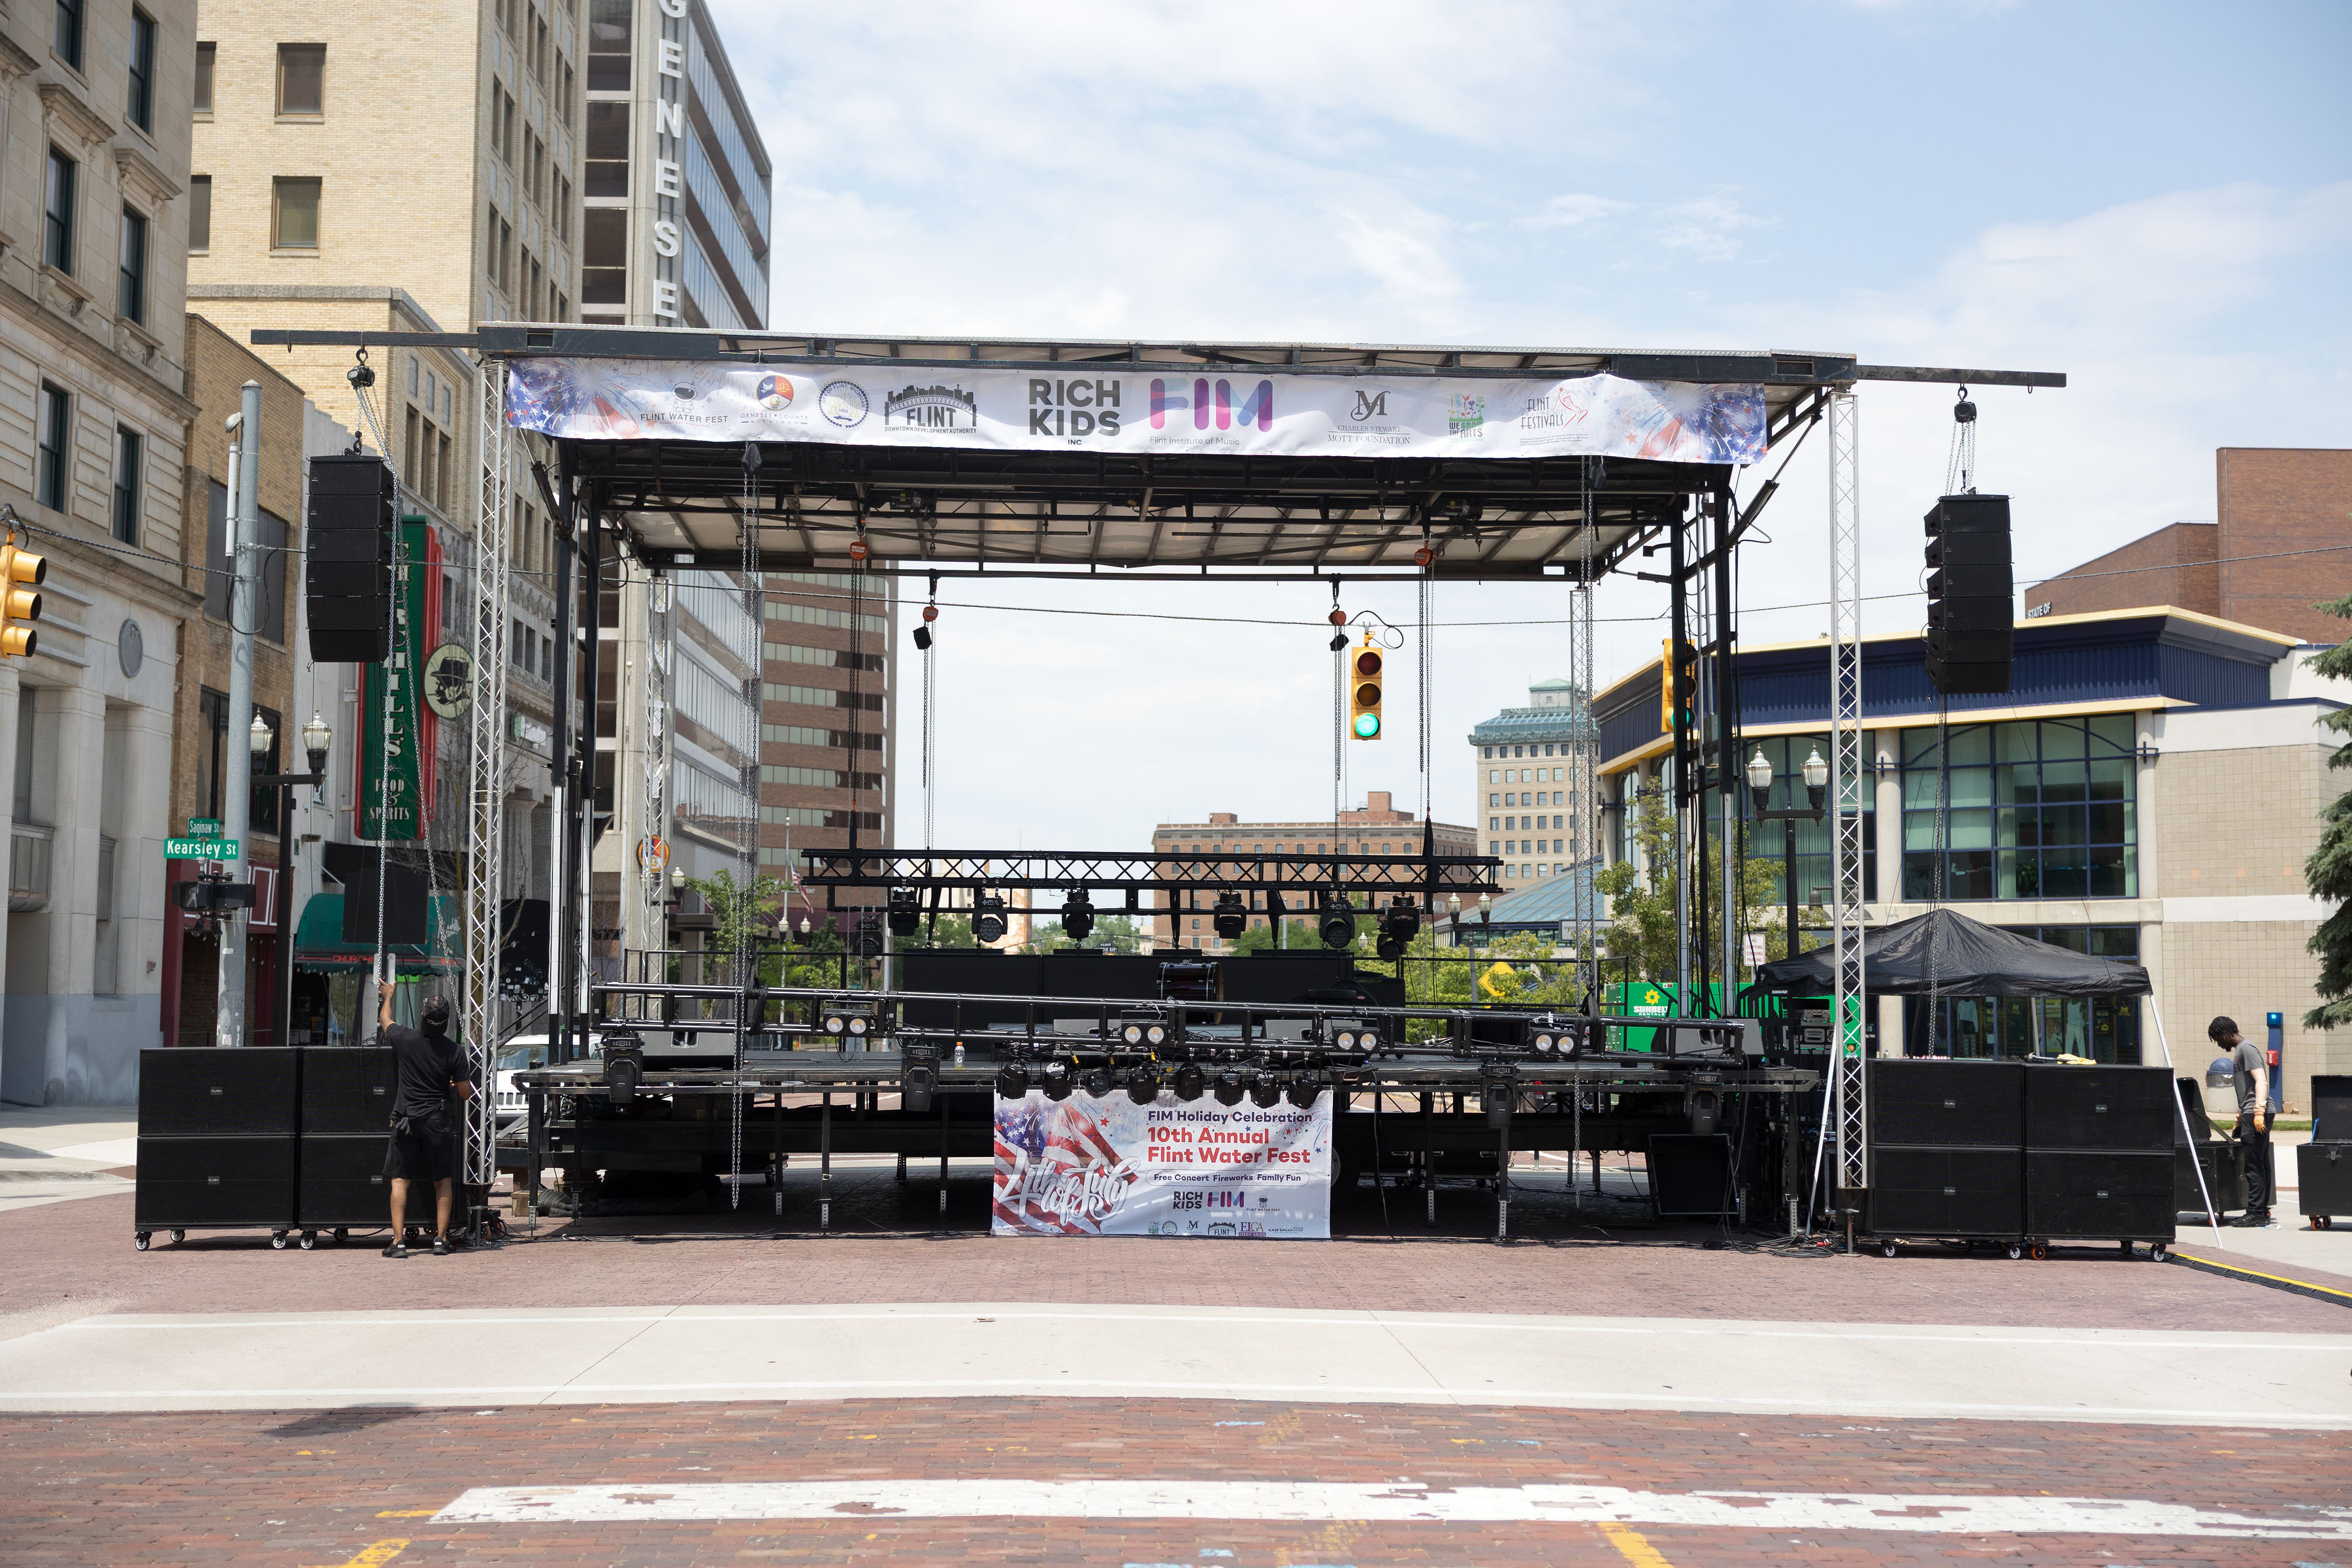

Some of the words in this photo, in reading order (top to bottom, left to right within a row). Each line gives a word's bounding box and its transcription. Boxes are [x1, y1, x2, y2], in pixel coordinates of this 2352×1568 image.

[850, 387, 866, 408] MICHIGAN
[1029, 378, 1120, 407] RICH
[1151, 378, 1273, 432] FIM
[1526, 397, 1550, 412] FLINT
[669, 413, 702, 423] WATER
[907, 406, 956, 427] FLINT
[1029, 408, 1120, 436] KIDS
[1520, 414, 1563, 429] FESTIVALS
[1356, 435, 1411, 444] FOUNDATION
[1460, 429, 1483, 438] ARTS
[2028, 605, 2044, 619] STATE
[2043, 602, 2051, 614] OF
[370, 807, 410, 820] SPRITS
[189, 820, 212, 836] Saginaw
[214, 823, 220, 833] St
[167, 840, 221, 858] Kearsley
[226, 844, 237, 855] St
[1148, 1111, 1173, 1121] FIM
[1177, 1111, 1228, 1124] Holiday
[1232, 1111, 1313, 1122] Celebration
[1148, 1127, 1192, 1143] 10th
[1198, 1128, 1269, 1144] Annual
[1148, 1146, 1193, 1162] Flint
[1198, 1147, 1262, 1164] Water
[1267, 1148, 1311, 1163] Fest
[1257, 1174, 1284, 1183] Family
[1173, 1191, 1203, 1200] RICH
[1207, 1191, 1244, 1207] FIM
